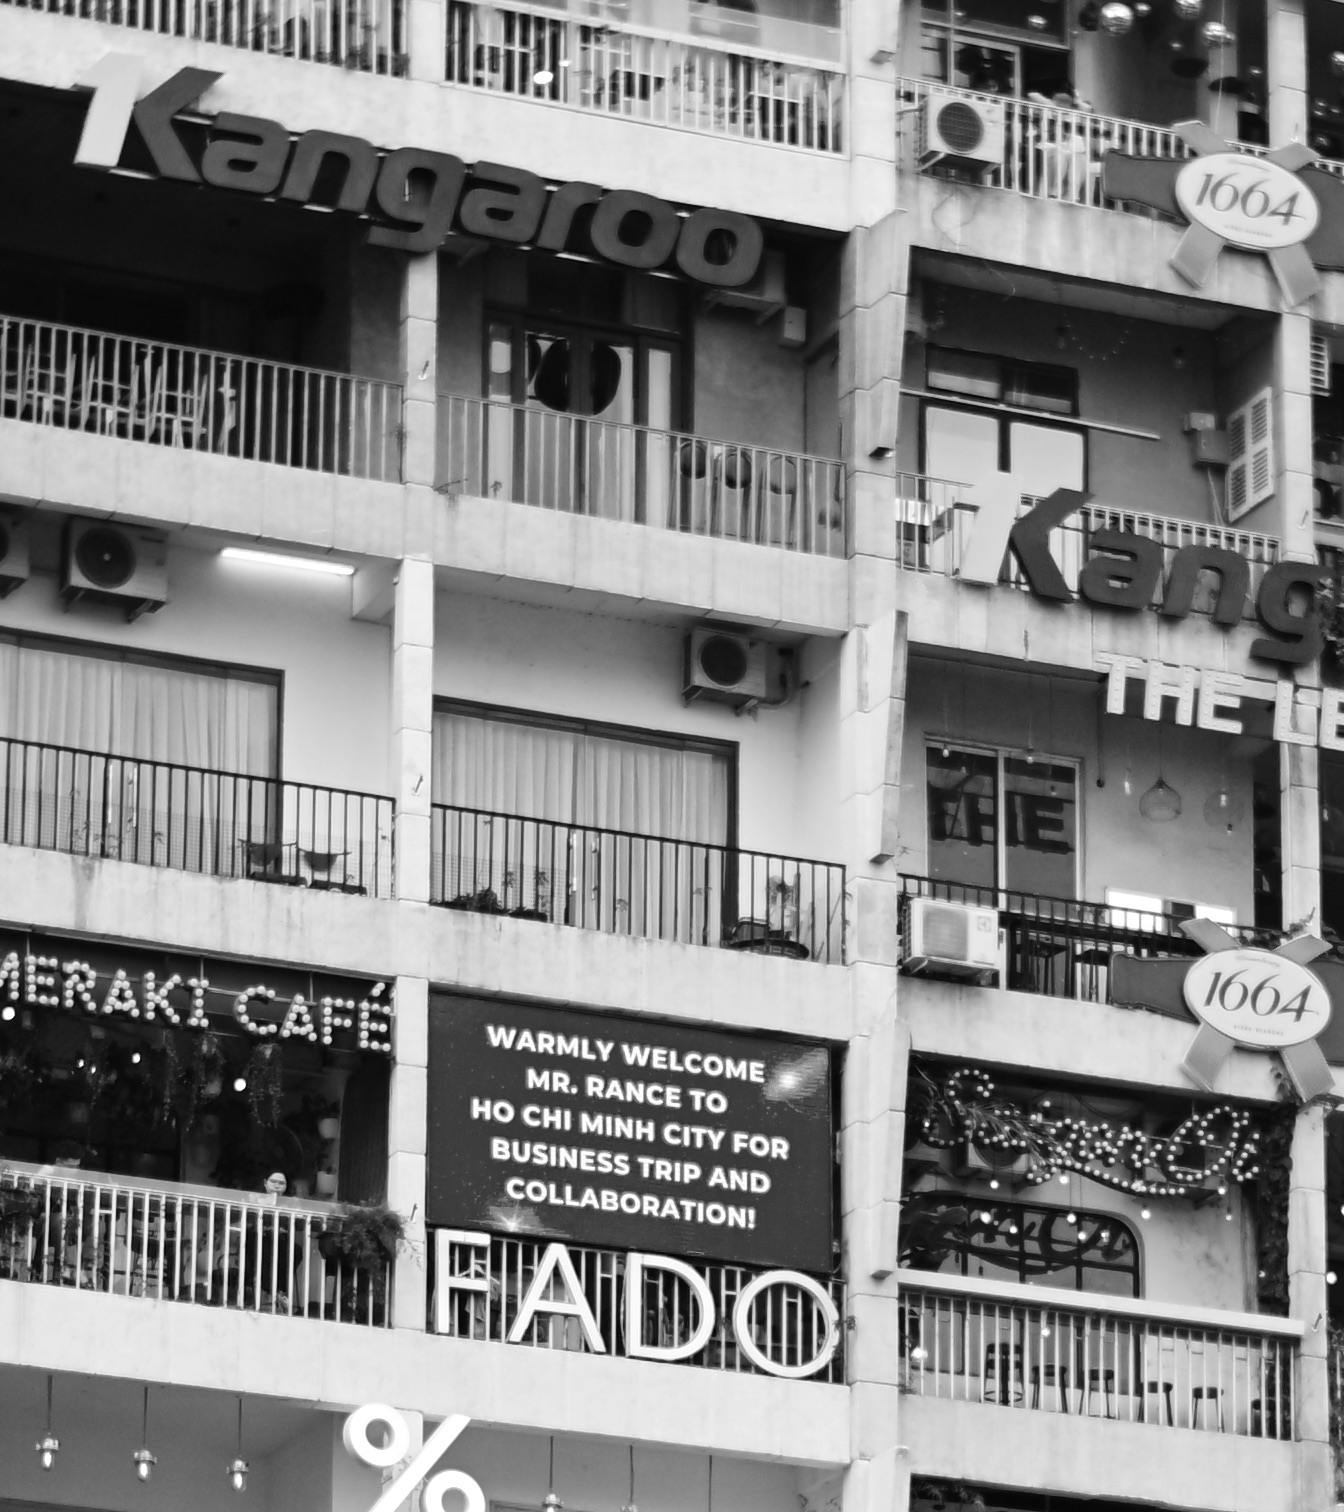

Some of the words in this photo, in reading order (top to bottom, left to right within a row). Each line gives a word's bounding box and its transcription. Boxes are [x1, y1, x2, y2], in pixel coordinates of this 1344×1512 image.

[72, 52, 765, 287] Kangaroo
[1195, 171, 1307, 226] 1664
[1097, 650, 1244, 735] THE
[234, 982, 395, 1051] CAFÉ
[1204, 969, 1320, 1023] 1664
[486, 1024, 615, 1062] WARMLY
[620, 1043, 766, 1083] WELCOME
[526, 1068, 579, 1095] MR.
[586, 1075, 681, 1108] RANCE
[689, 1090, 729, 1115] TO
[470, 1097, 515, 1124] HO
[522, 1105, 572, 1131] CHI
[580, 1110, 655, 1142] MINH
[663, 1124, 725, 1151] CITY
[731, 1133, 791, 1161] FOR
[490, 1138, 630, 1176] BUSINESS
[637, 1155, 702, 1185] TRIP
[708, 1167, 772, 1194] AND
[505, 1177, 757, 1230] COLLABORATION!
[435, 1228, 842, 1380] FADO
